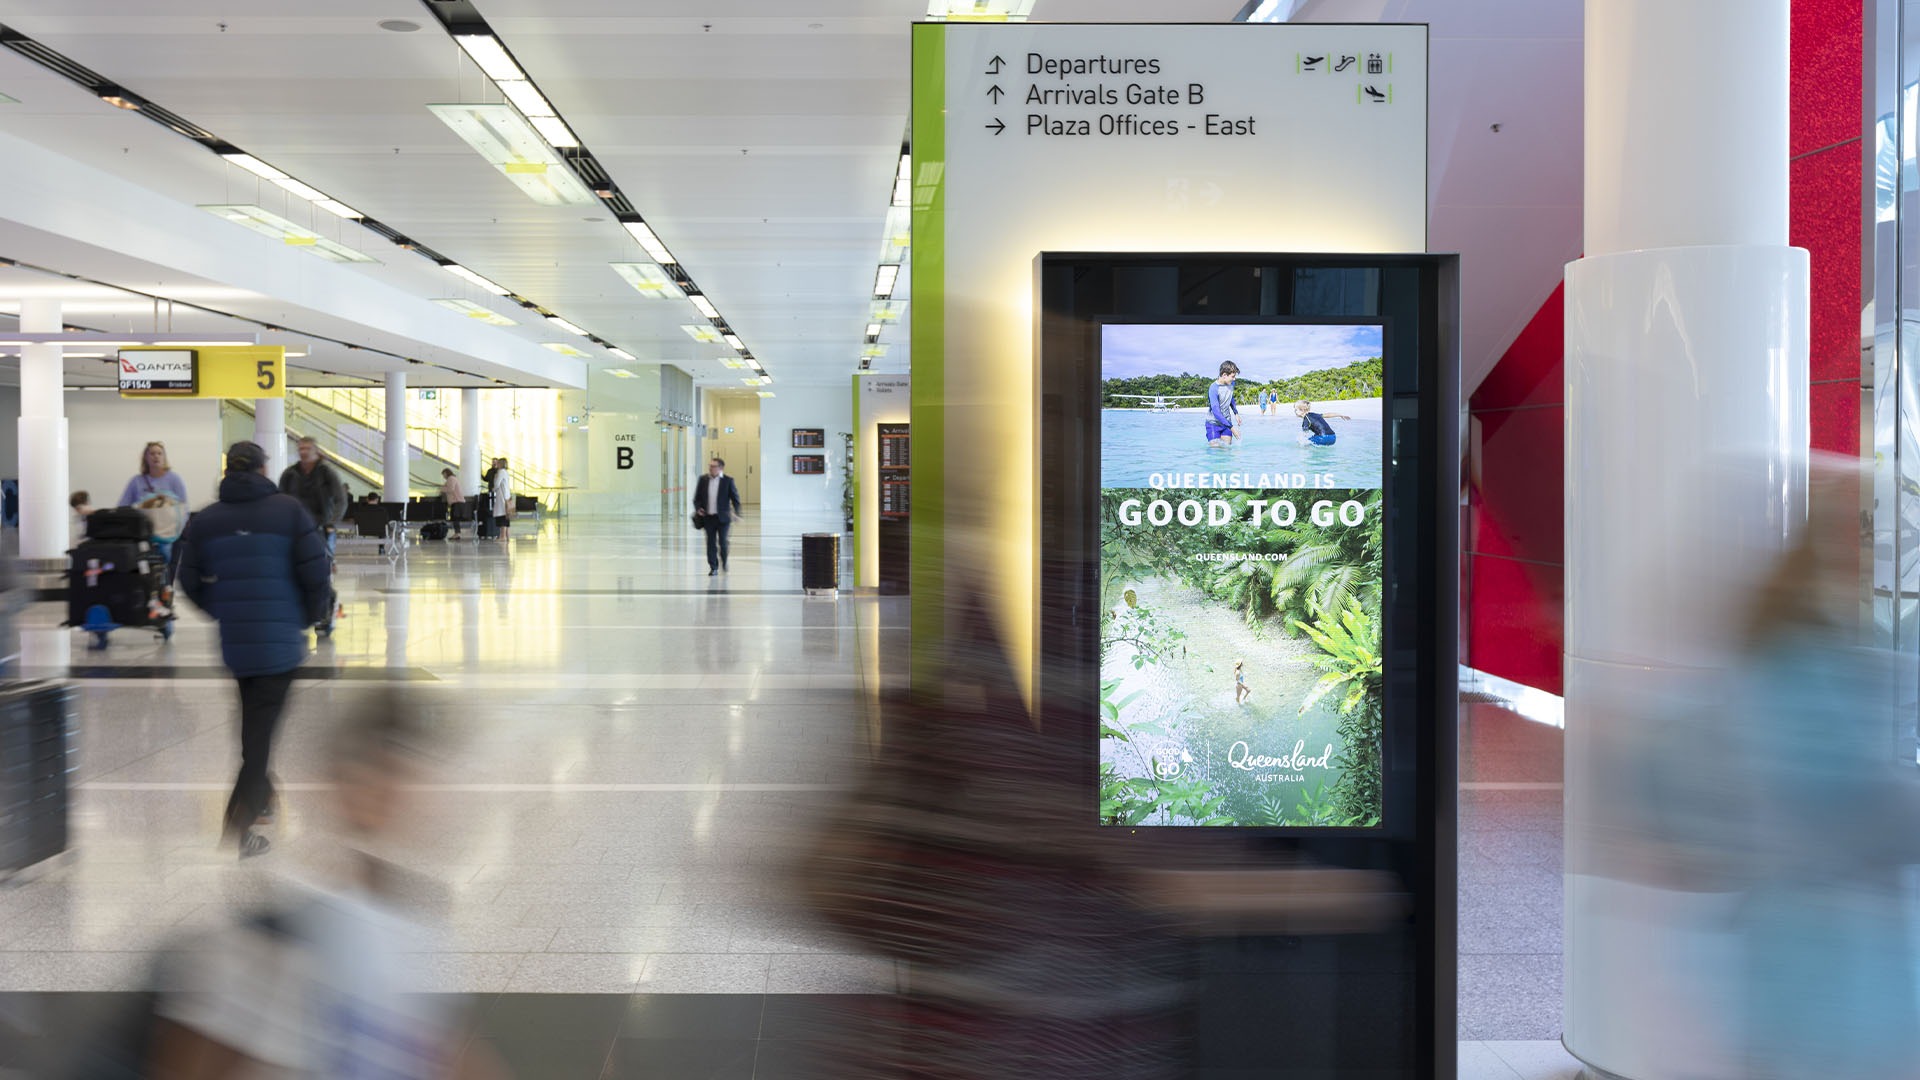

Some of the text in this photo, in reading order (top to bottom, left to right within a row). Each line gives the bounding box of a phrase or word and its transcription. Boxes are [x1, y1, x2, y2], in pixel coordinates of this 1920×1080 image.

[1027, 53, 1161, 80] Departures
[1025, 83, 1204, 105] Arrivals Gate B
[1027, 114, 1091, 135] Plaza
[1099, 114, 1179, 135] Offices
[1205, 114, 1256, 135] East
[136, 362, 192, 371] QANTAS
[257, 361, 275, 390] 5
[615, 434, 636, 442] GATE
[616, 446, 634, 470] B
[1148, 473, 1335, 490] QUEENSLAND IS
[1118, 499, 1365, 527] GOOD TO GO
[1195, 553, 1288, 563] QUEENSLAND.COM
[1228, 739, 1335, 771] Queensland
[1156, 762, 1180, 775] GO
[1255, 774, 1305, 782] AUSTRALIA
